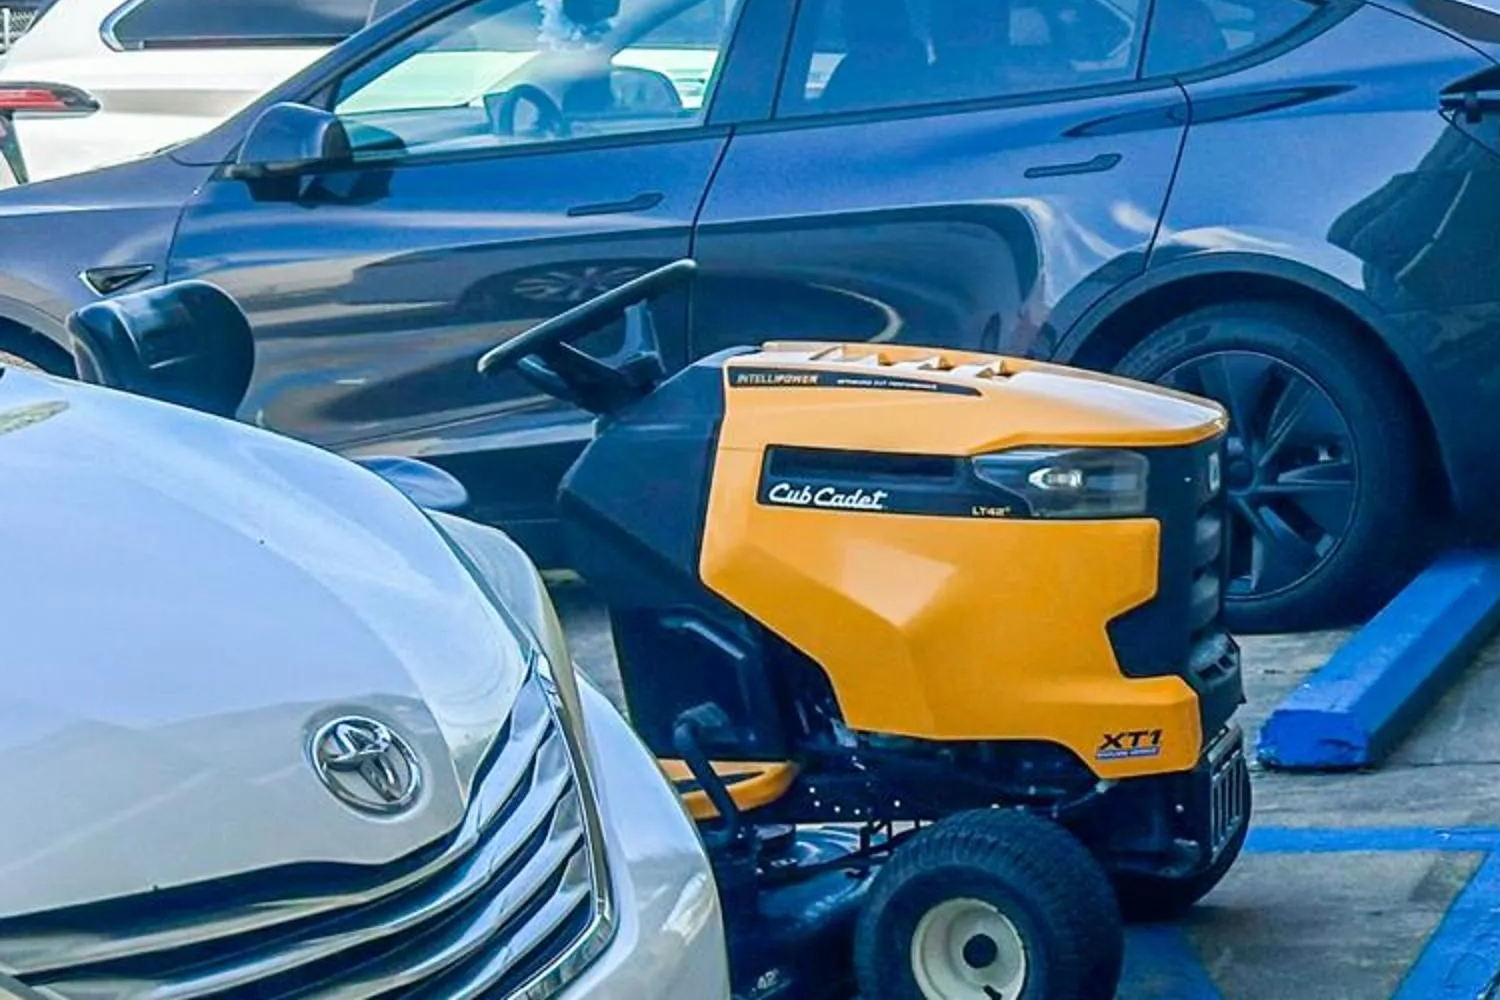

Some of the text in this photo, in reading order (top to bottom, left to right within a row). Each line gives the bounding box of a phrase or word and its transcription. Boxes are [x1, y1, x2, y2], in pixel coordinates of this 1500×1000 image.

[768, 482, 888, 509] Cub Cadet
[1100, 729, 1162, 750] XT1
